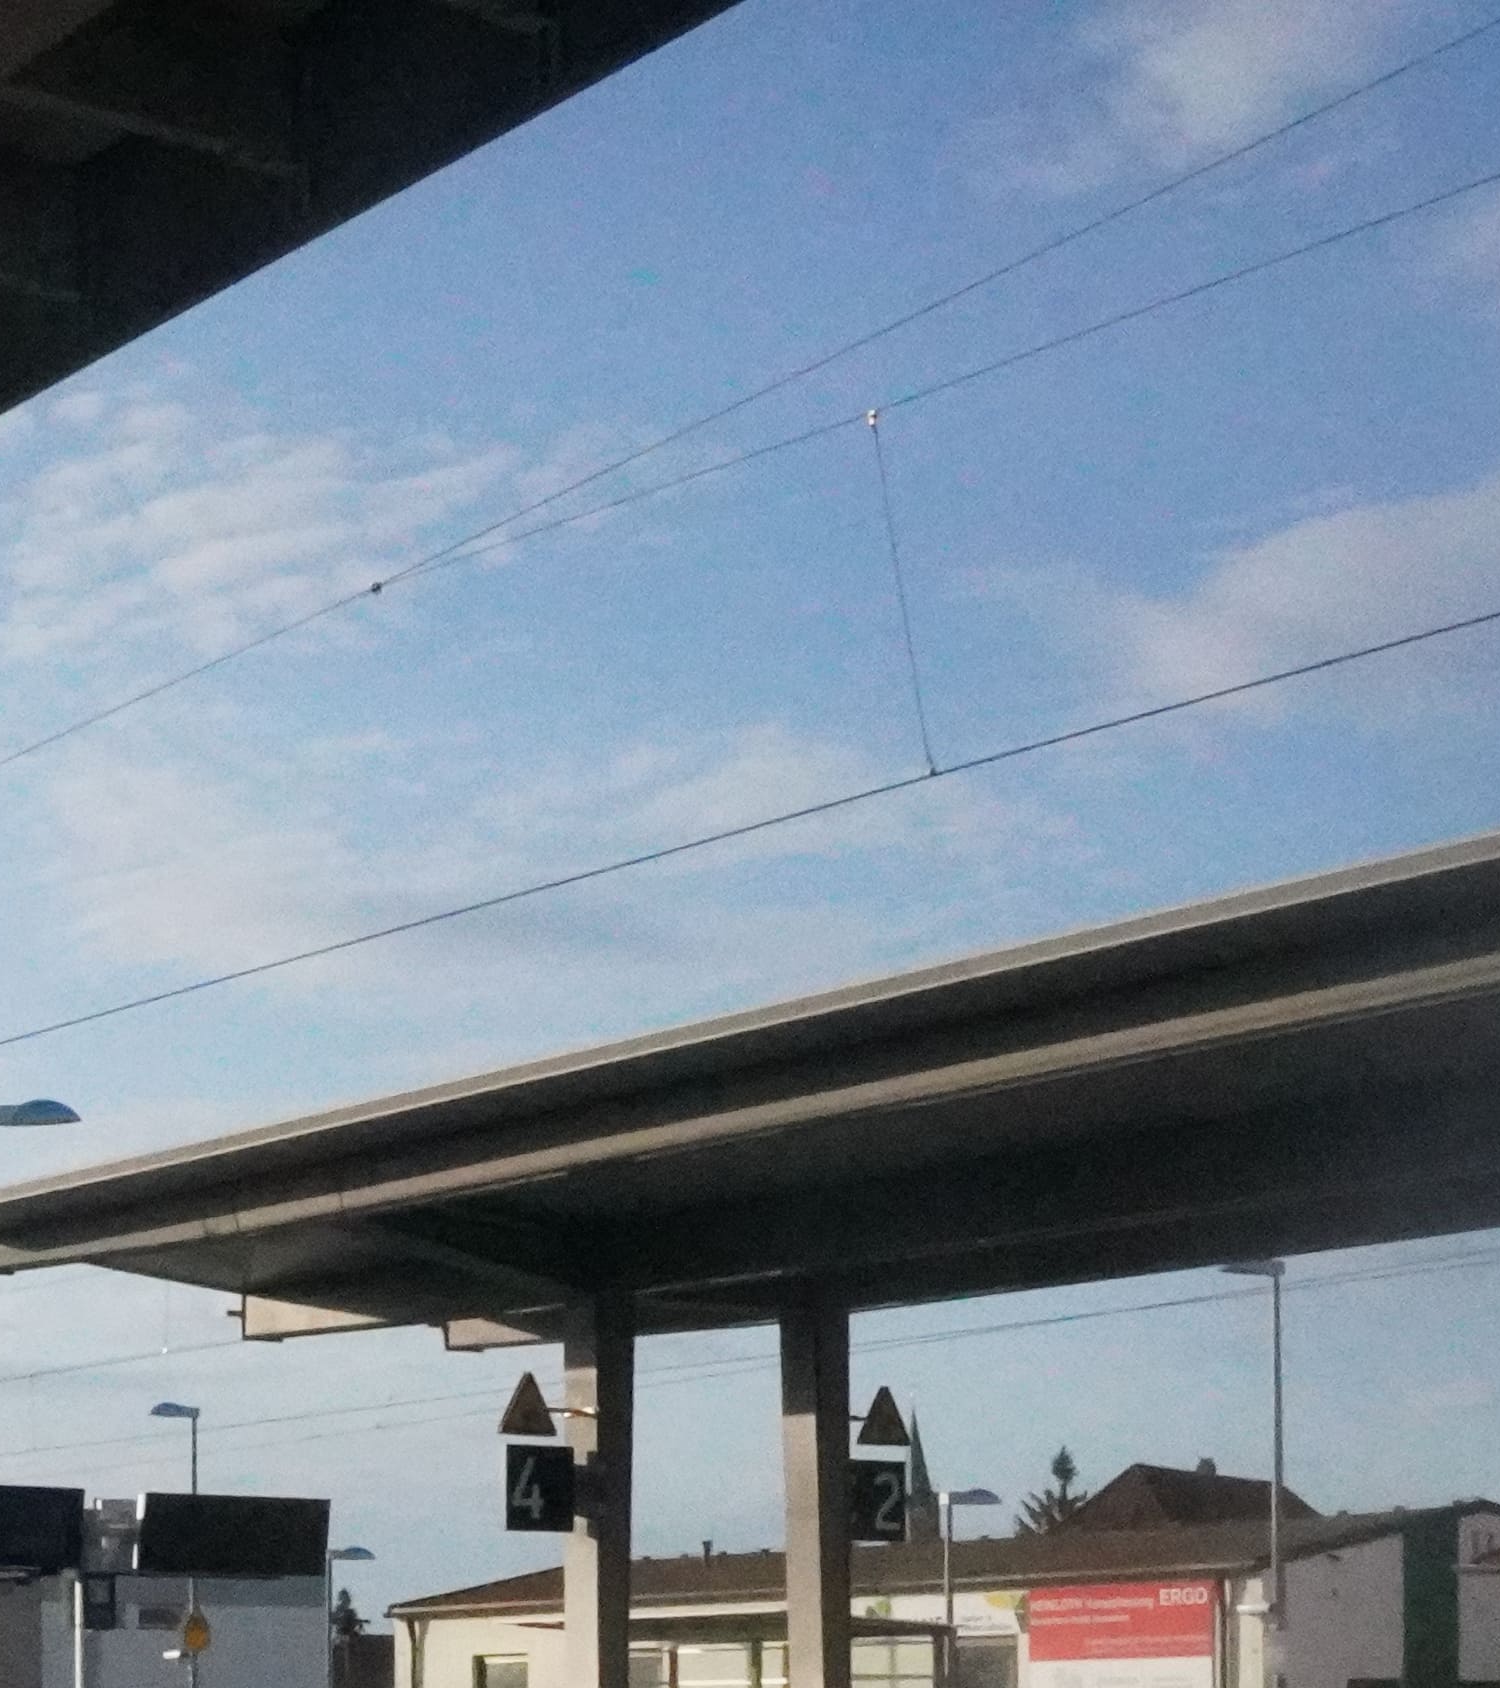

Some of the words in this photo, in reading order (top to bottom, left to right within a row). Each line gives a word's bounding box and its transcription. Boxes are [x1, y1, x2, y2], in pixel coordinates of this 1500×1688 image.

[511, 1456, 545, 1521] 4
[873, 1472, 902, 1531] 2
[1159, 1587, 1208, 1606] ERGO
